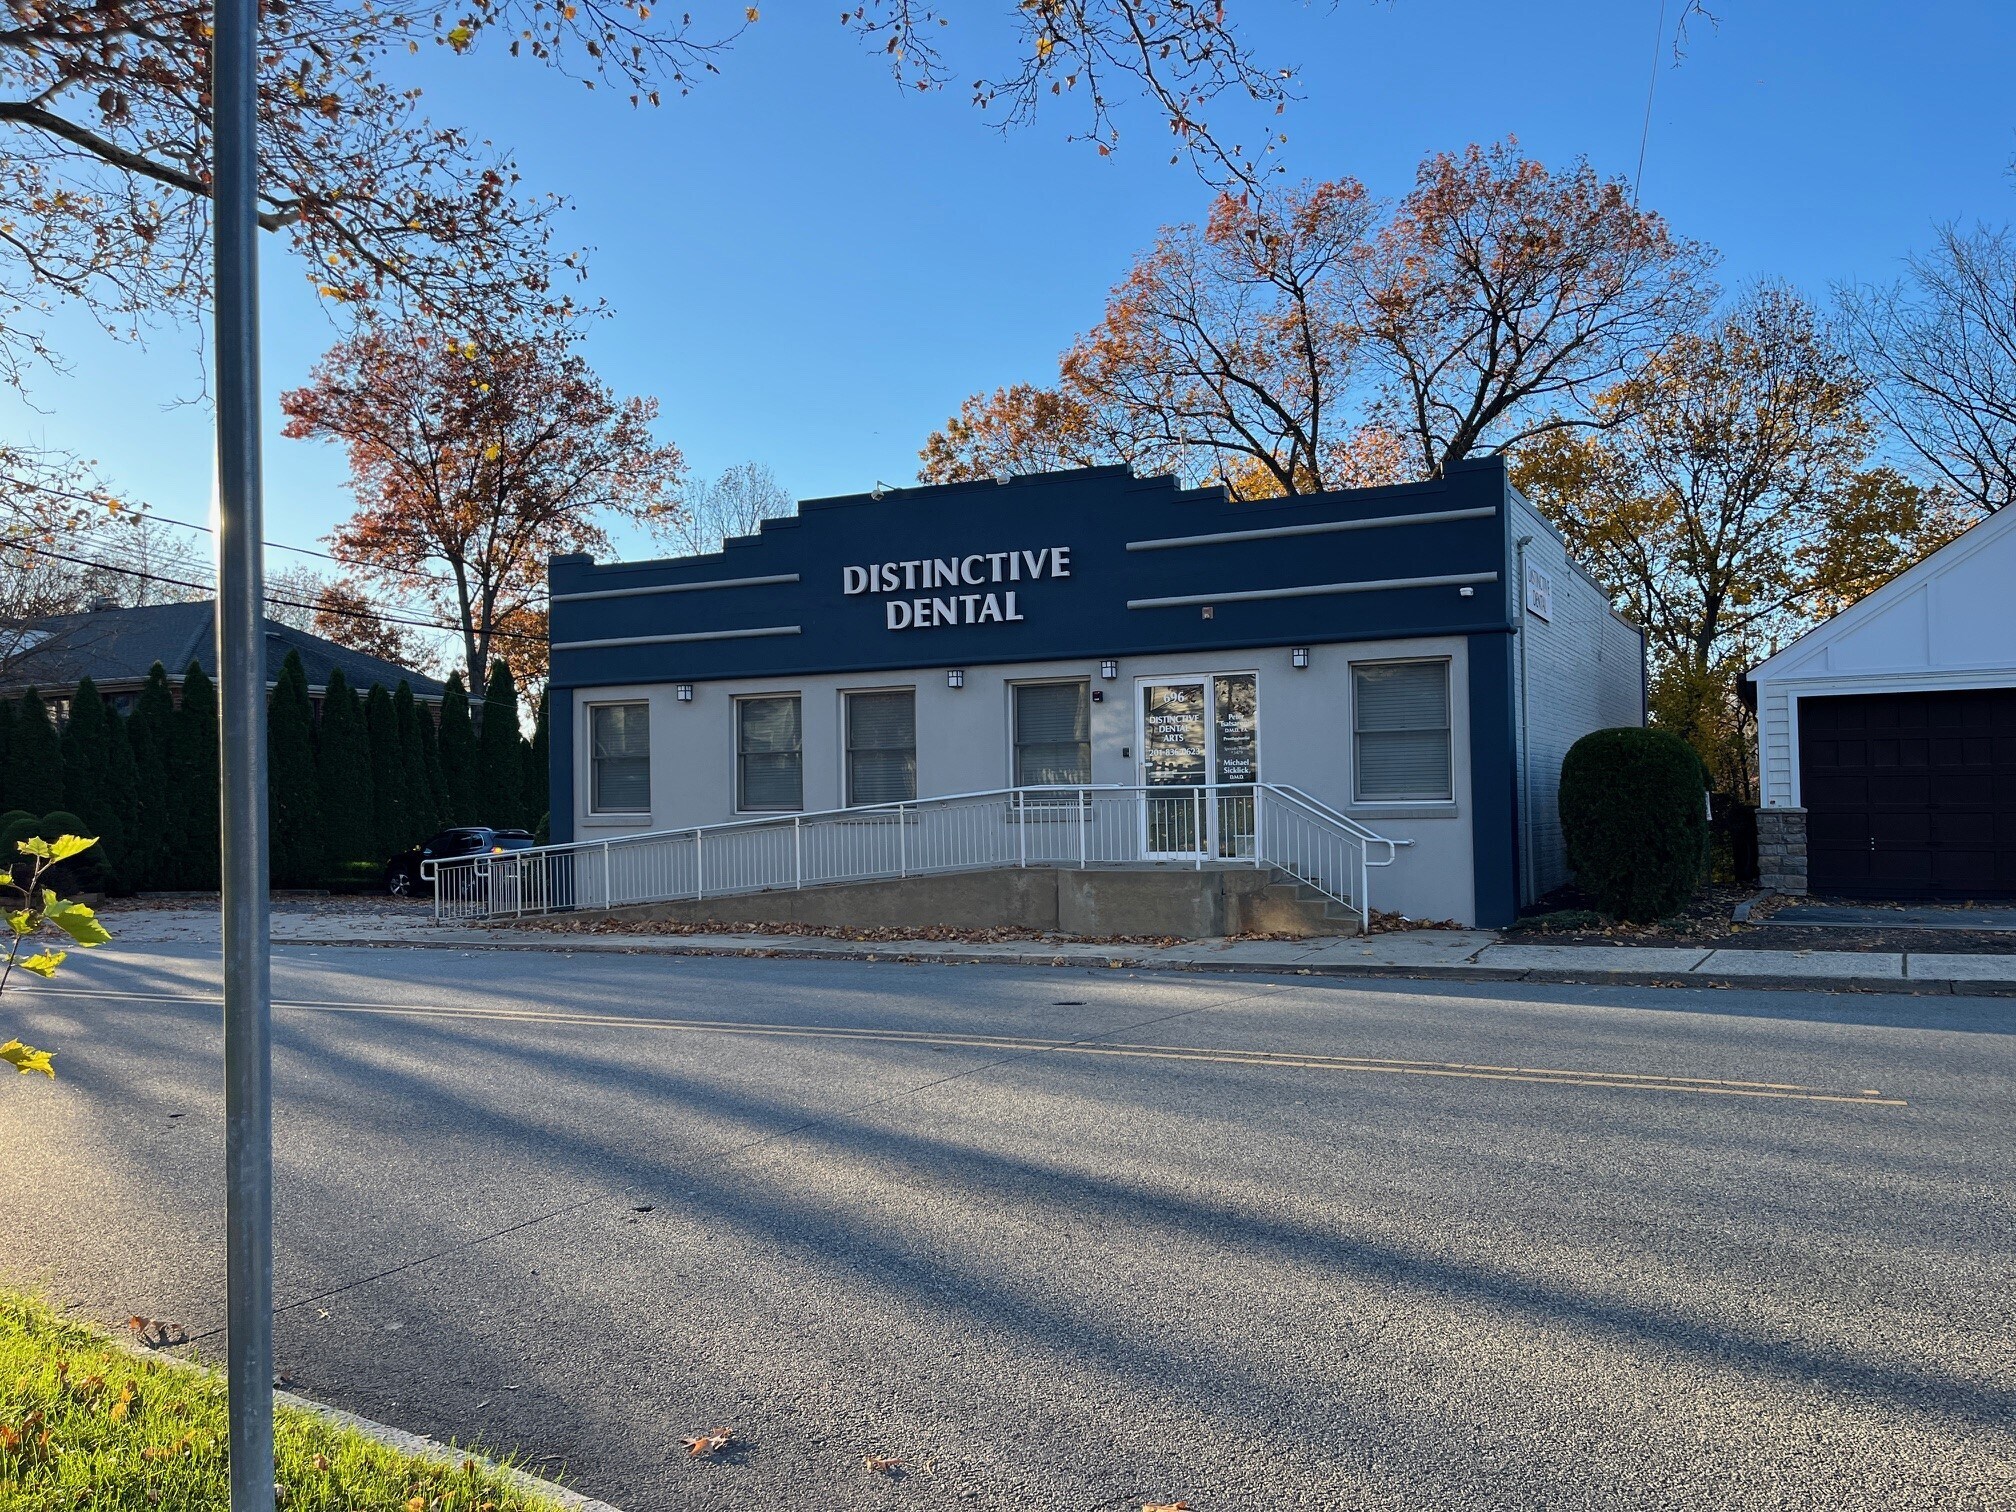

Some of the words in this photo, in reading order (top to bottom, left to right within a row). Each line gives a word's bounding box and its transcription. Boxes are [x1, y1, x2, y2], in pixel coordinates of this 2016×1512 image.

[843, 547, 1070, 595] DISTINCTIVE
[886, 591, 1024, 630] DENTAL
[1163, 691, 1185, 703] 696
[1149, 715, 1200, 724] DISTINCTIVE
[1158, 725, 1189, 733] DENTAL
[1163, 734, 1184, 742] ARTS
